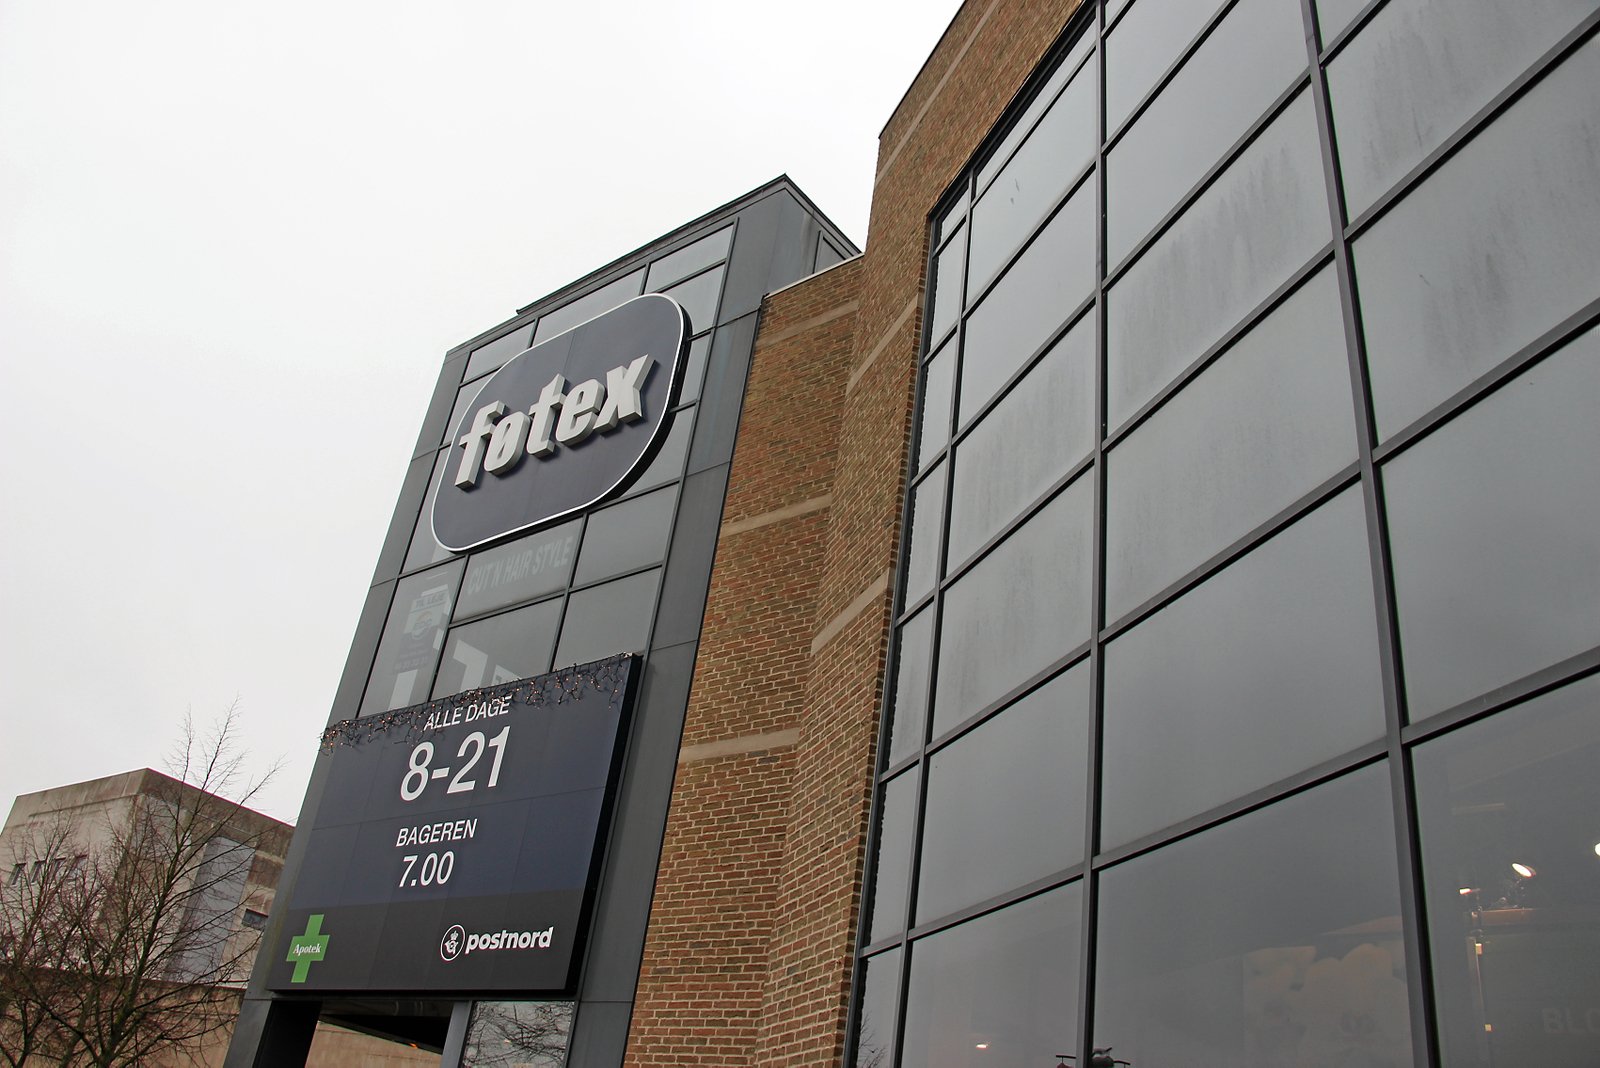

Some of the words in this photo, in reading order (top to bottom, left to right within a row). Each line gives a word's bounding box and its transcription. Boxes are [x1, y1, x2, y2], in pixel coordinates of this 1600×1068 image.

[423, 707, 464, 732] ALLE
[464, 694, 513, 723] DAGE
[400, 725, 511, 802] 8-21
[395, 818, 478, 848] BAGEREN
[399, 851, 455, 889] 7.00
[292, 943, 322, 957] Apotek
[464, 926, 554, 955] postnord
